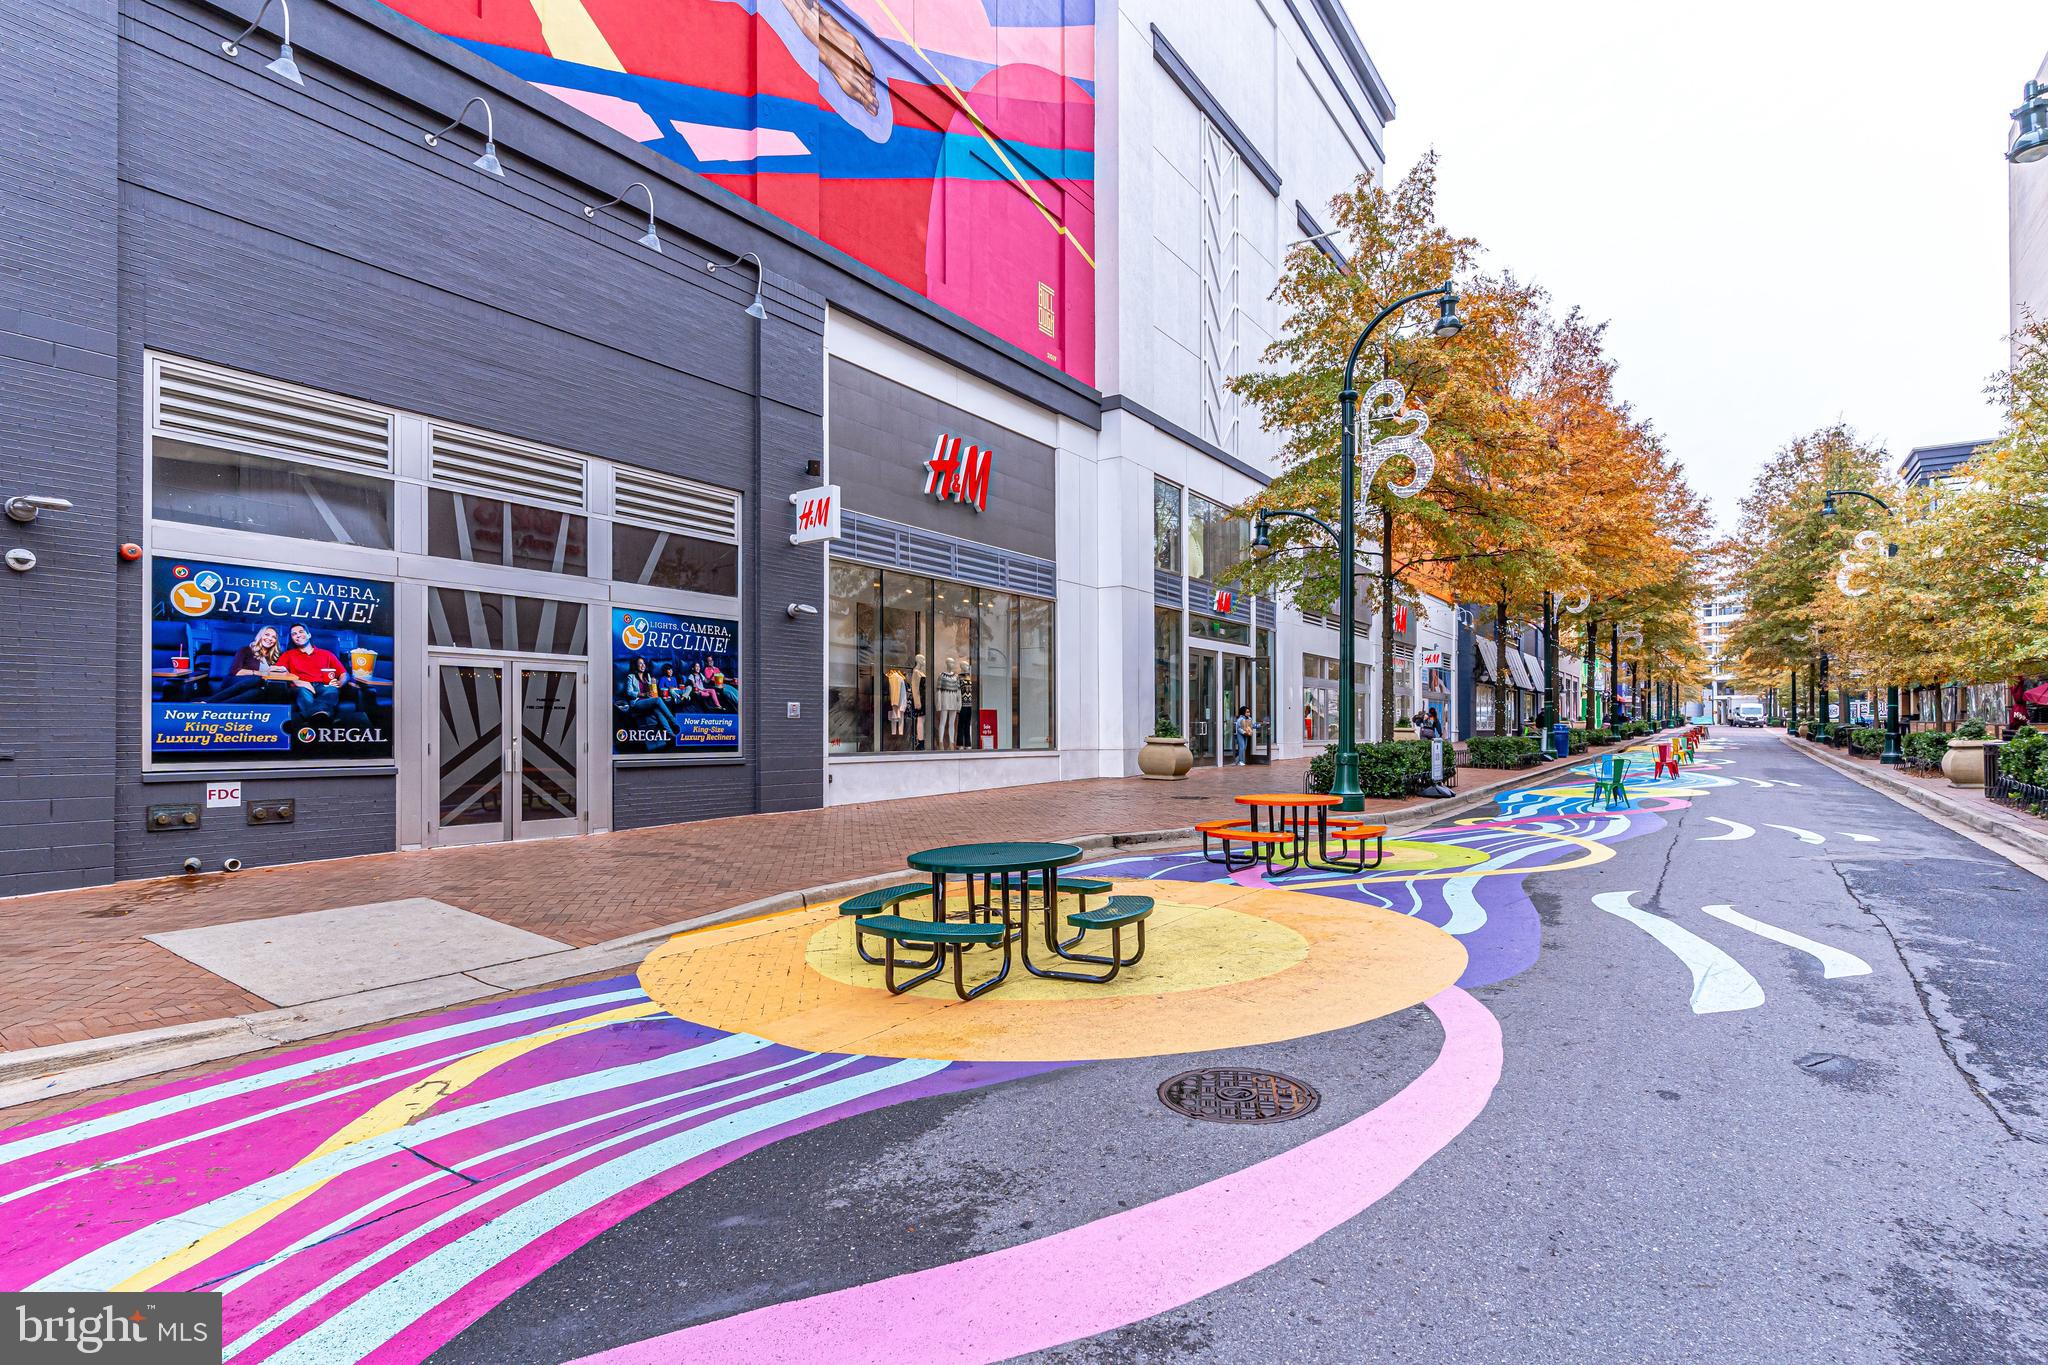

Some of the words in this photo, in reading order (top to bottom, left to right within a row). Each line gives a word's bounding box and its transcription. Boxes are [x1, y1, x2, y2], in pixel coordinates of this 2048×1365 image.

[923, 433, 993, 513] H&M
[799, 496, 831, 531] H&M
[226, 576, 282, 592] LIGHTS,
[287, 580, 380, 603] CAMERA,
[218, 590, 376, 624] RECLINE!
[1214, 590, 1232, 614] HM
[681, 622, 732, 637] CAMERA,
[646, 631, 730, 653] RECLINE!
[164, 710, 199, 720] Now
[202, 710, 271, 723] Featuring
[701, 718, 733, 726] Featuring
[184, 722, 253, 734] King-Size
[693, 726, 724, 734] King-Size
[156, 733, 211, 746] Luxury
[214, 733, 278, 744] Recliners
[318, 728, 387, 742] REGAL
[629, 729, 671, 741] REGAL
[680, 733, 705, 743] Luxury
[706, 733, 736, 741] Recliners
[208, 788, 239, 800] FDC
